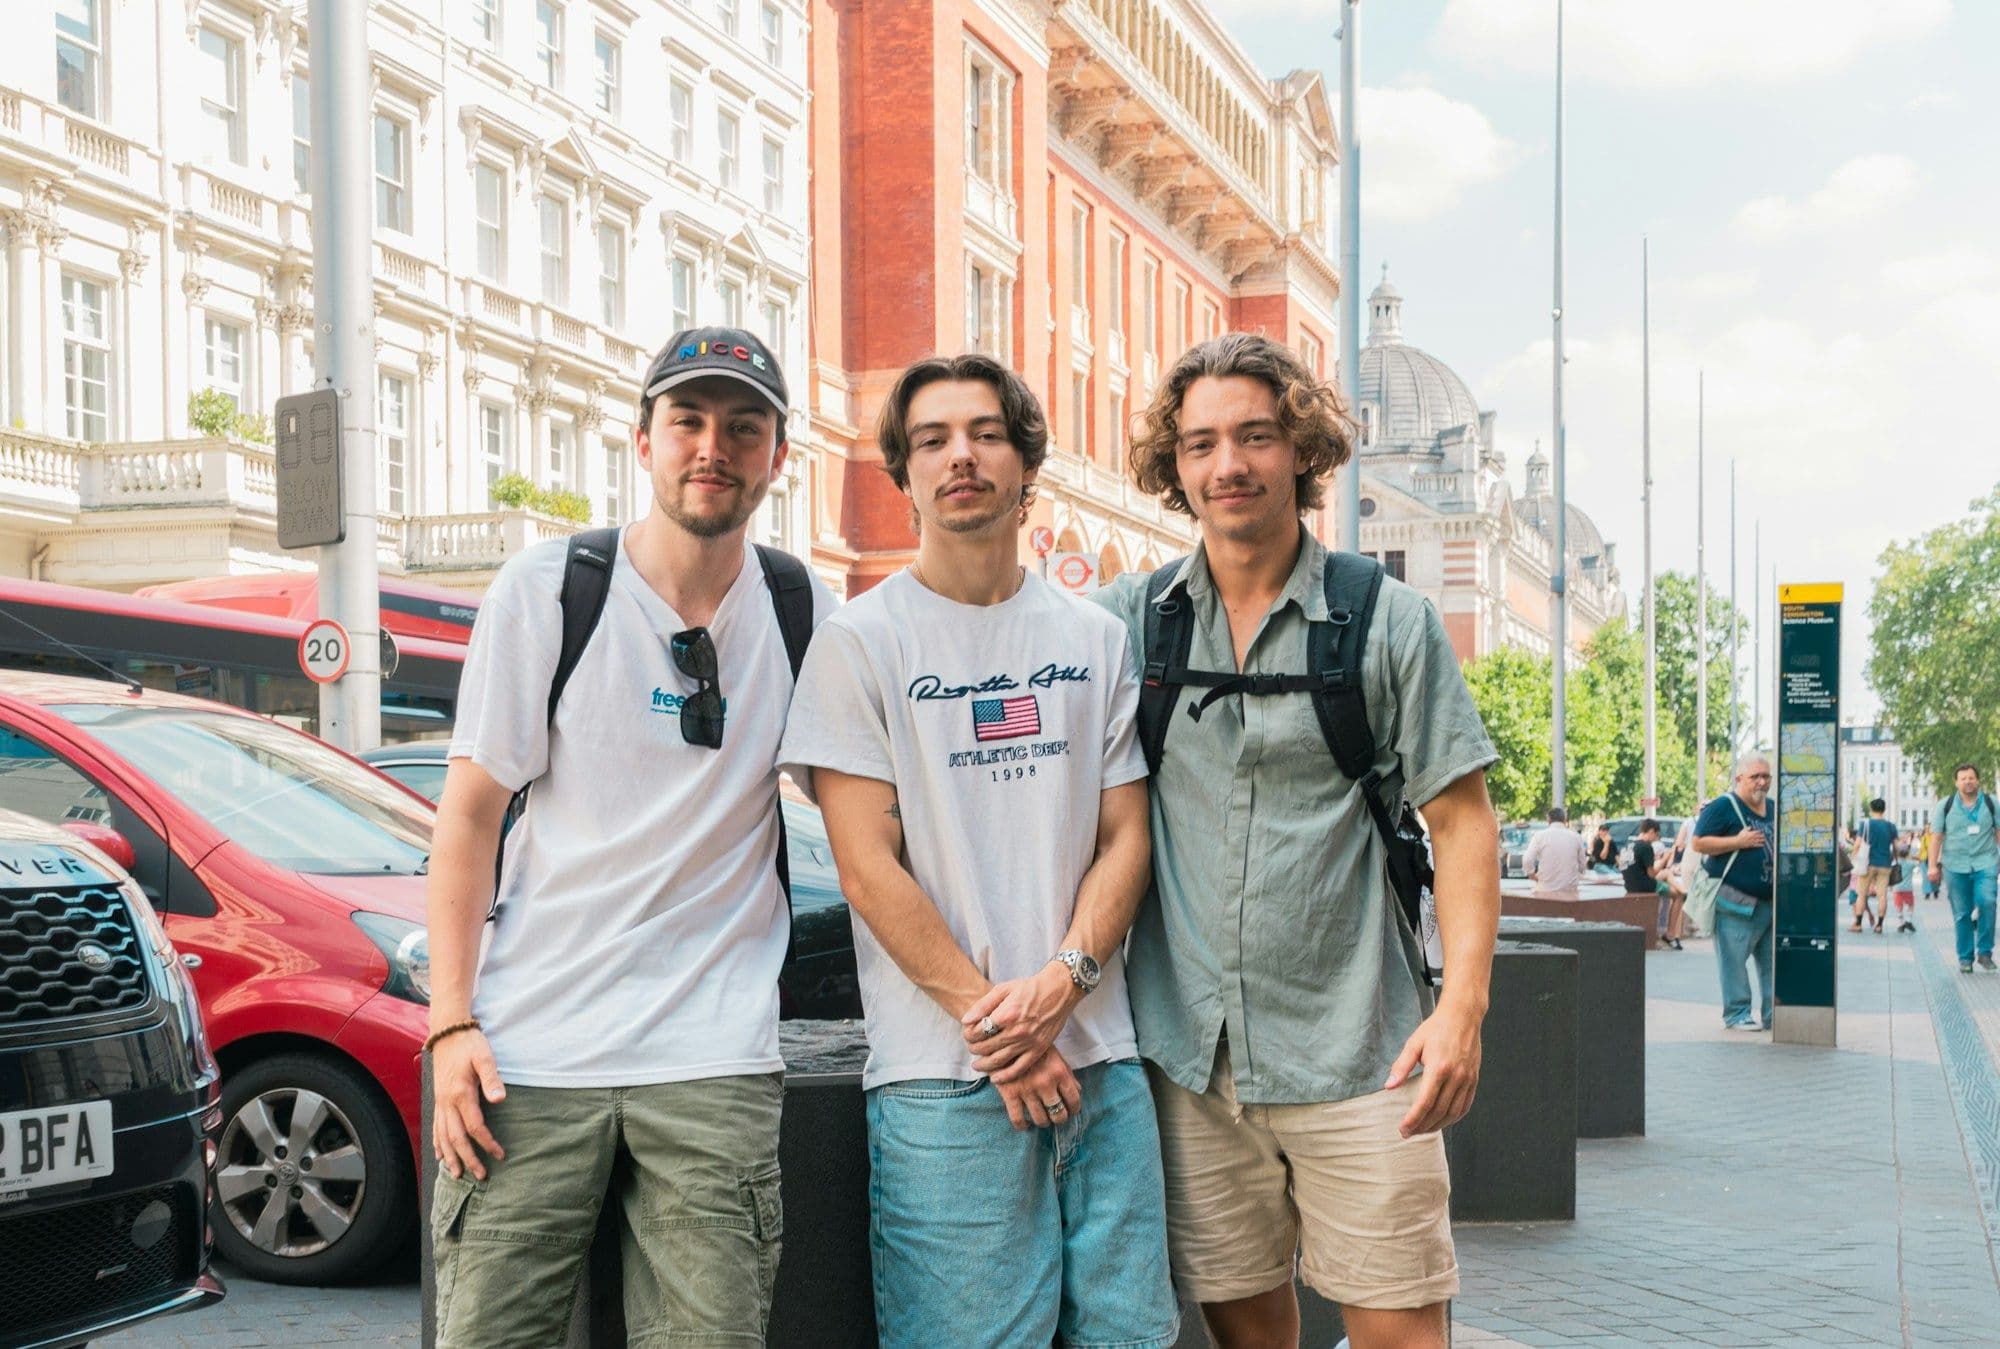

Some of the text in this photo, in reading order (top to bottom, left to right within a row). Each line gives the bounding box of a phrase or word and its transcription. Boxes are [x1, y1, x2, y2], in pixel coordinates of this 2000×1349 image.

[679, 340, 766, 371] NICCE
[1033, 528, 1050, 551] K
[308, 639, 341, 662] 20
[949, 745, 1028, 768] ATHLETIC
[991, 765, 1036, 782] 1998
[20, 1111, 95, 1175] BFA
